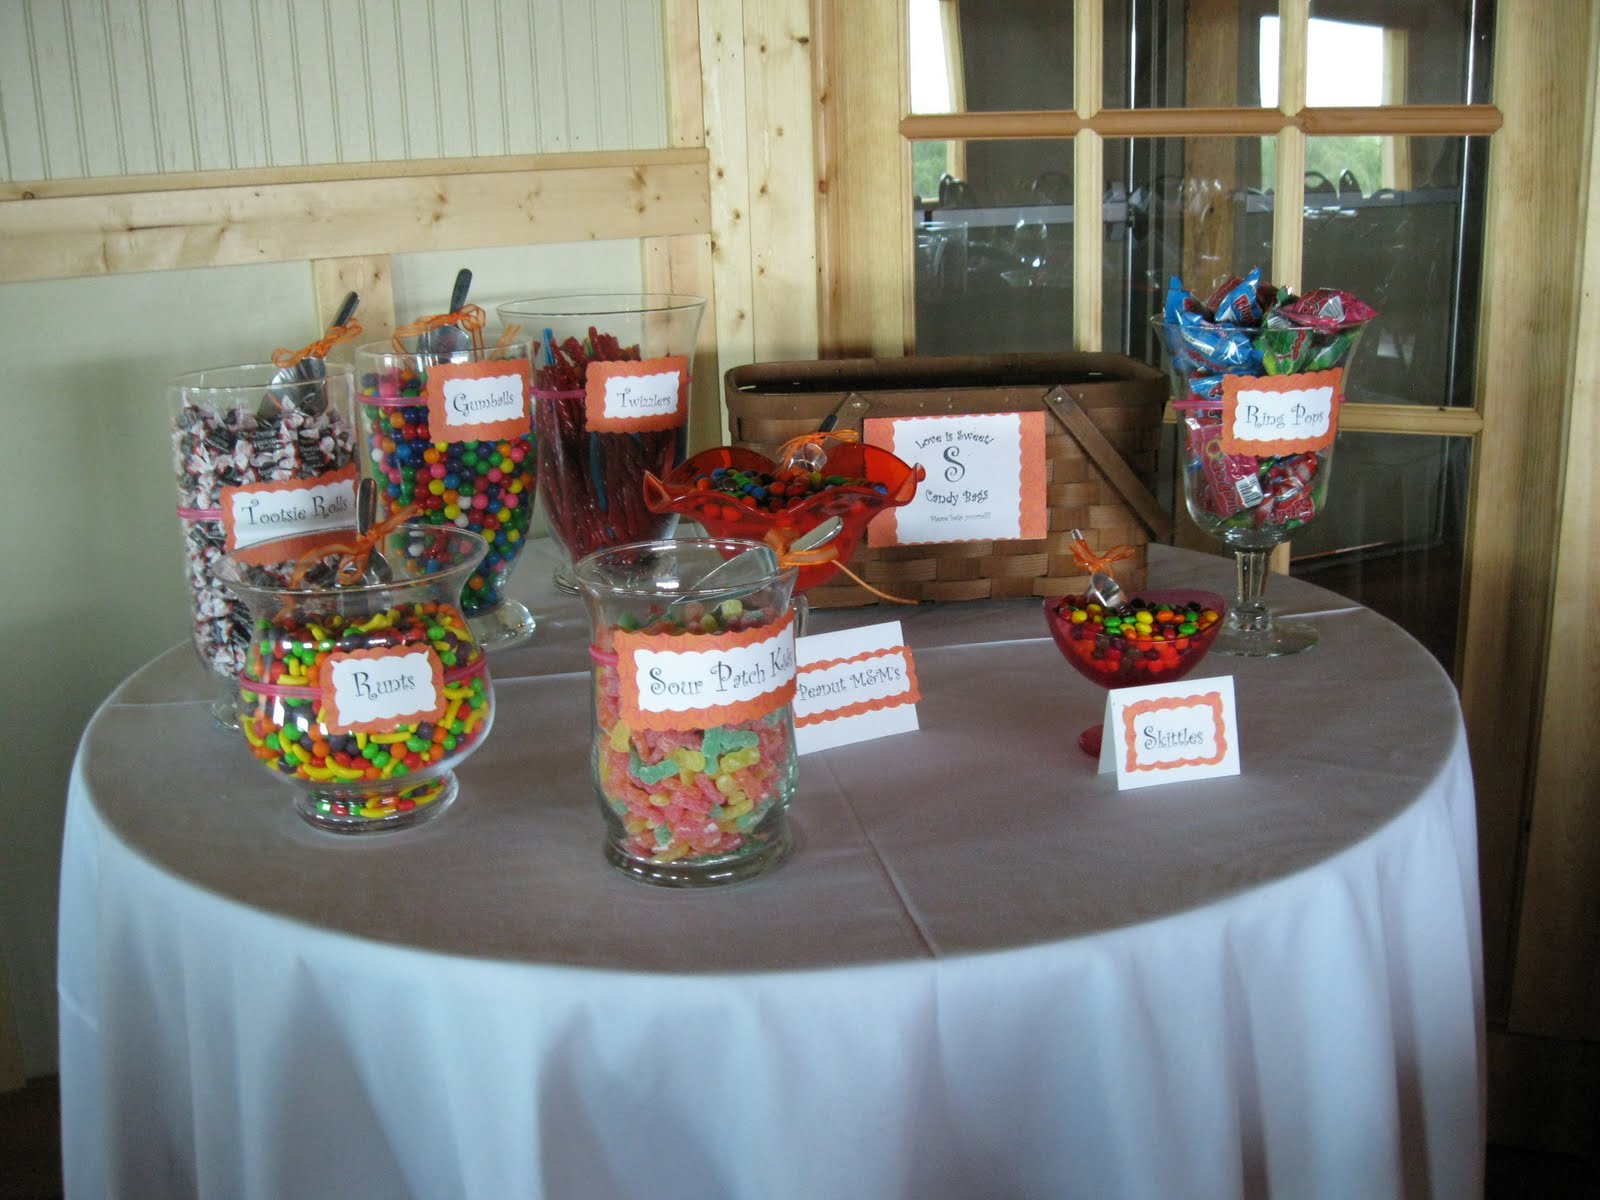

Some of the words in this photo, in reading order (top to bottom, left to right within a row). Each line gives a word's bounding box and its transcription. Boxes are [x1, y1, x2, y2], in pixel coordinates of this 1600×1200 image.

[453, 391, 514, 416] Gumballs
[617, 387, 671, 407] Twizzlers
[1246, 405, 1285, 428] Ring
[1291, 403, 1324, 426] Pops
[915, 436, 942, 449] Love
[943, 446, 966, 482] S
[241, 499, 306, 525] Tootsie
[312, 495, 348, 519] Rolls
[925, 489, 959, 506] Candy
[962, 489, 989, 504] Bags
[352, 671, 416, 701] Runts
[649, 667, 703, 696] Sour
[710, 660, 766, 692] Patch
[797, 678, 847, 701] Peanut
[849, 666, 901, 688] M&M's
[1143, 725, 1205, 750] Skittles
